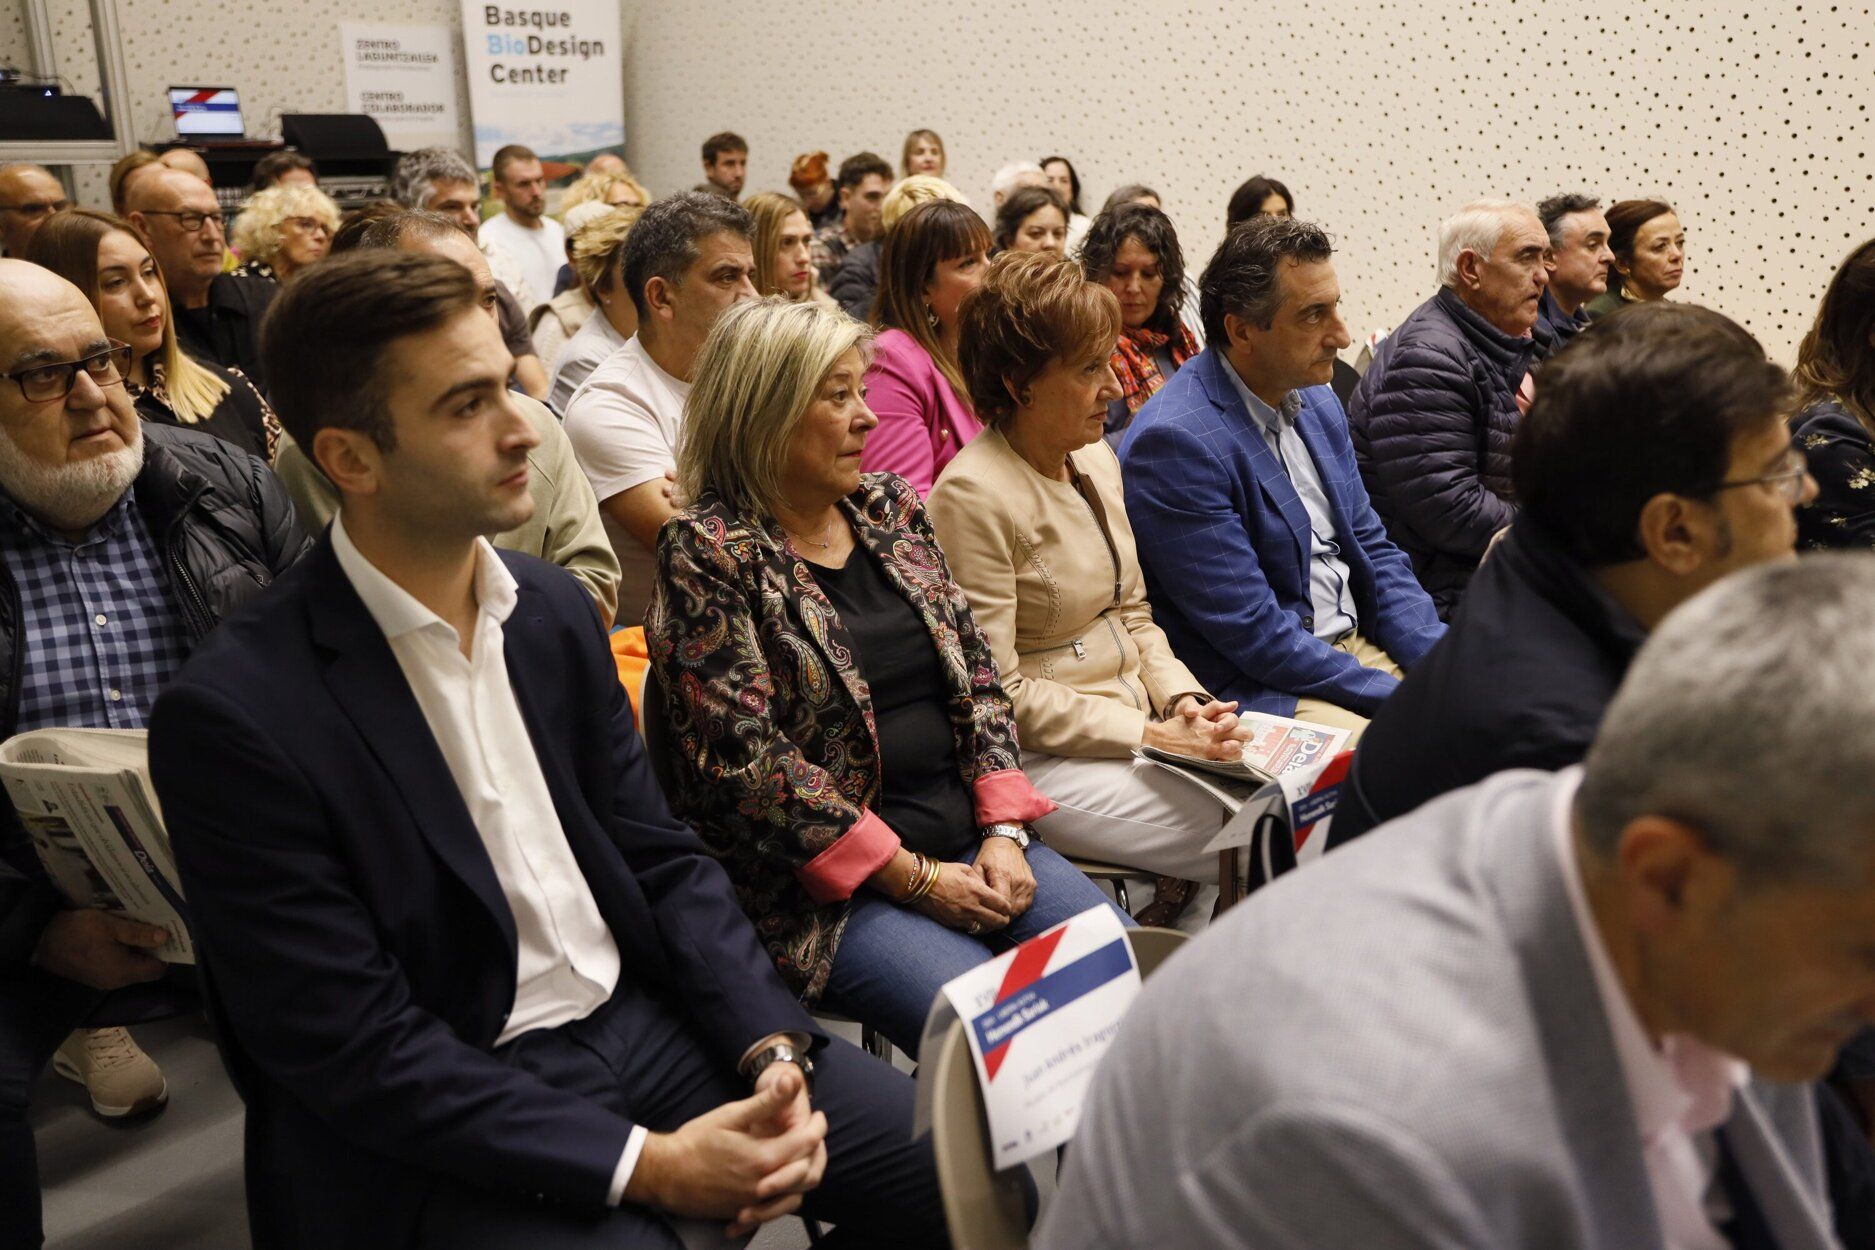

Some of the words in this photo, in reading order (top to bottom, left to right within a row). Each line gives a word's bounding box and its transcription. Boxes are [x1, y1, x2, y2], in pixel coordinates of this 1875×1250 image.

[485, 5, 571, 31] Basque
[487, 34, 605, 60] BioDesign
[490, 63, 568, 84] Center
